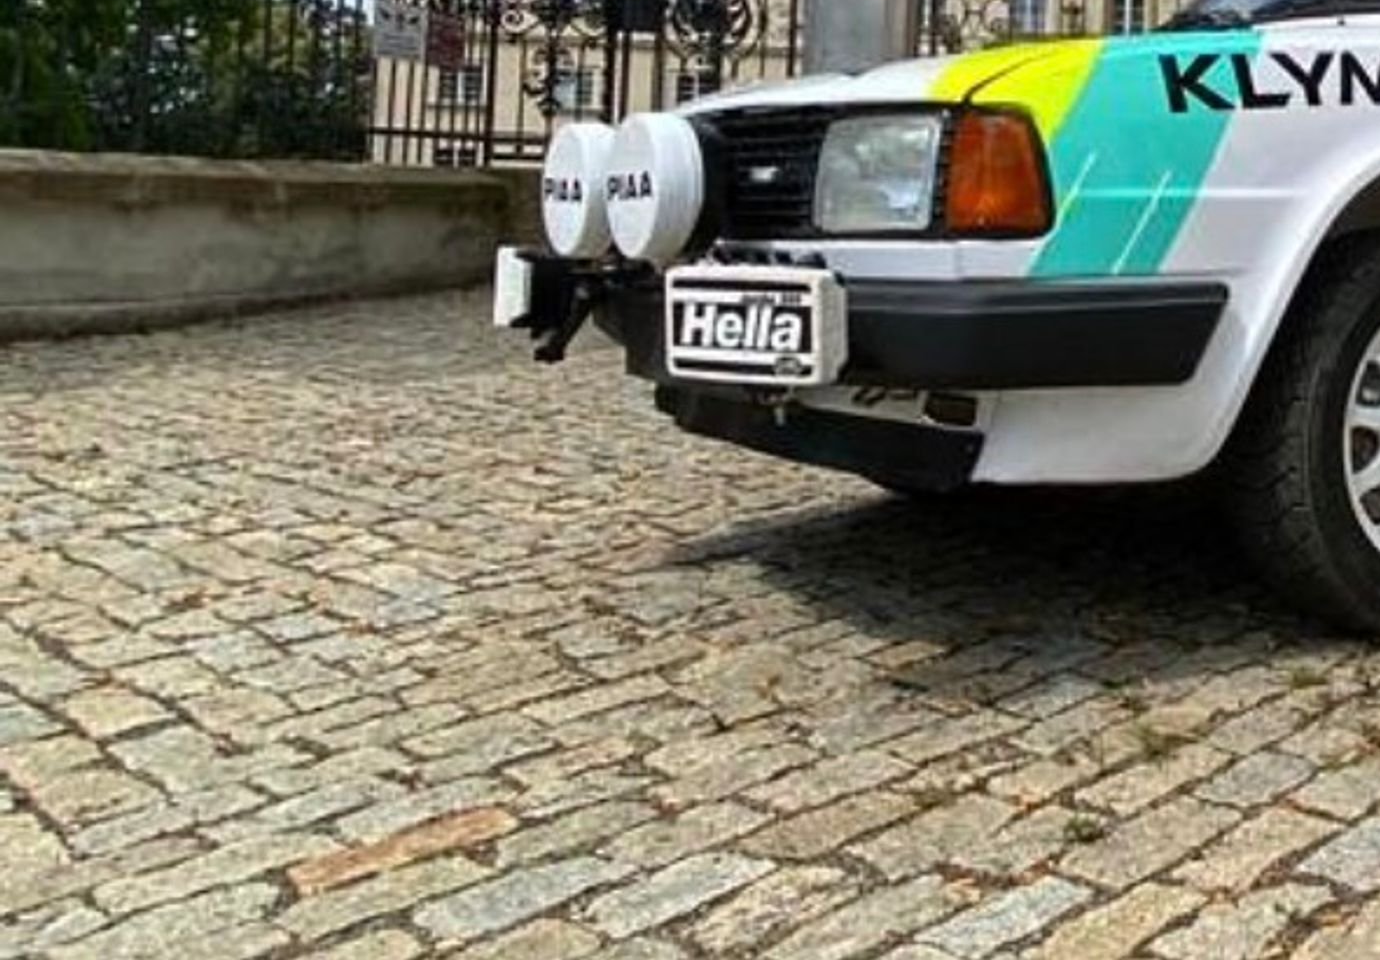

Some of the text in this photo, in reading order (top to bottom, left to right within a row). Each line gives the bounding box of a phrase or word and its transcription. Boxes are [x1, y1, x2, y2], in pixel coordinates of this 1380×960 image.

[544, 177, 582, 202] PIAA
[607, 170, 653, 201] PIAA
[679, 302, 801, 352] Hella
